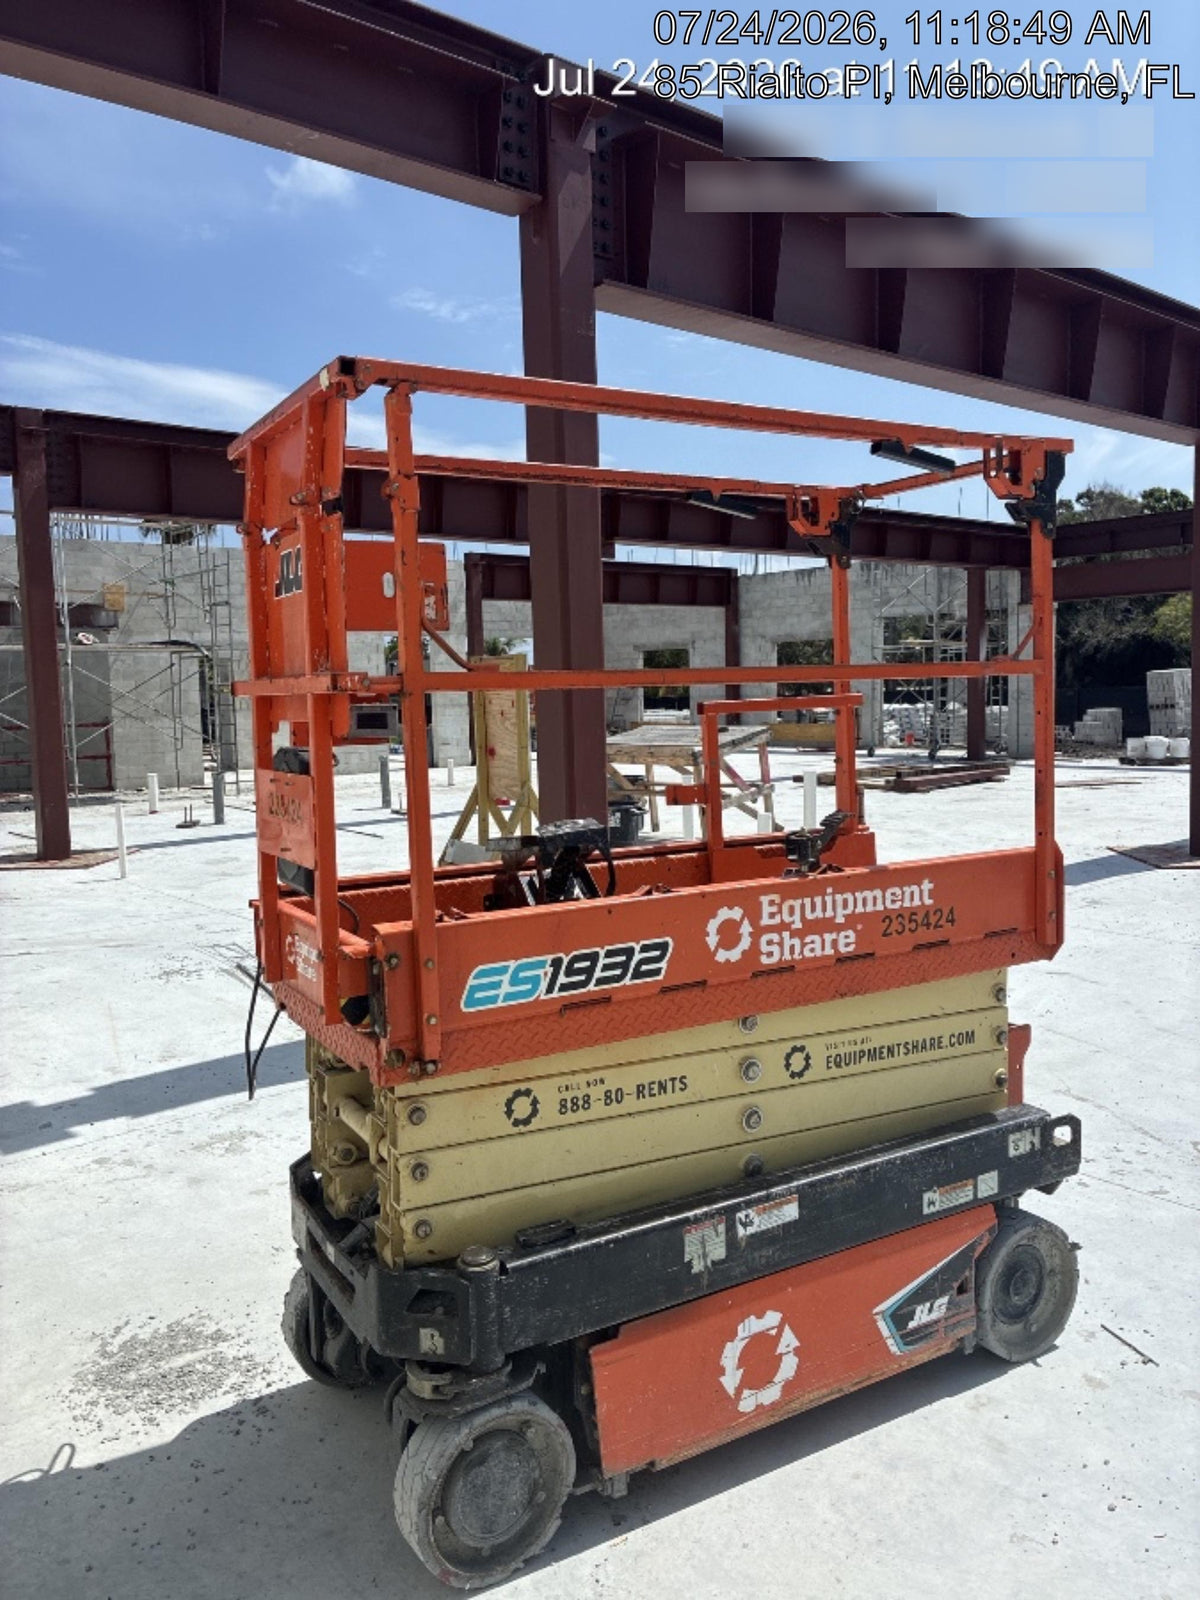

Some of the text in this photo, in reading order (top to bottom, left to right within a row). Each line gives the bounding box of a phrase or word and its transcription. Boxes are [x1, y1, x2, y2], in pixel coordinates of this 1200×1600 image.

[759, 878, 935, 930] Equipment
[880, 906, 957, 938] 235424
[759, 929, 857, 965] Share
[460, 936, 674, 1012] ES1932
[826, 1029, 976, 1071] EQUIPMENTSHARE.COM
[558, 1075, 689, 1116] 888-80-RENTS
